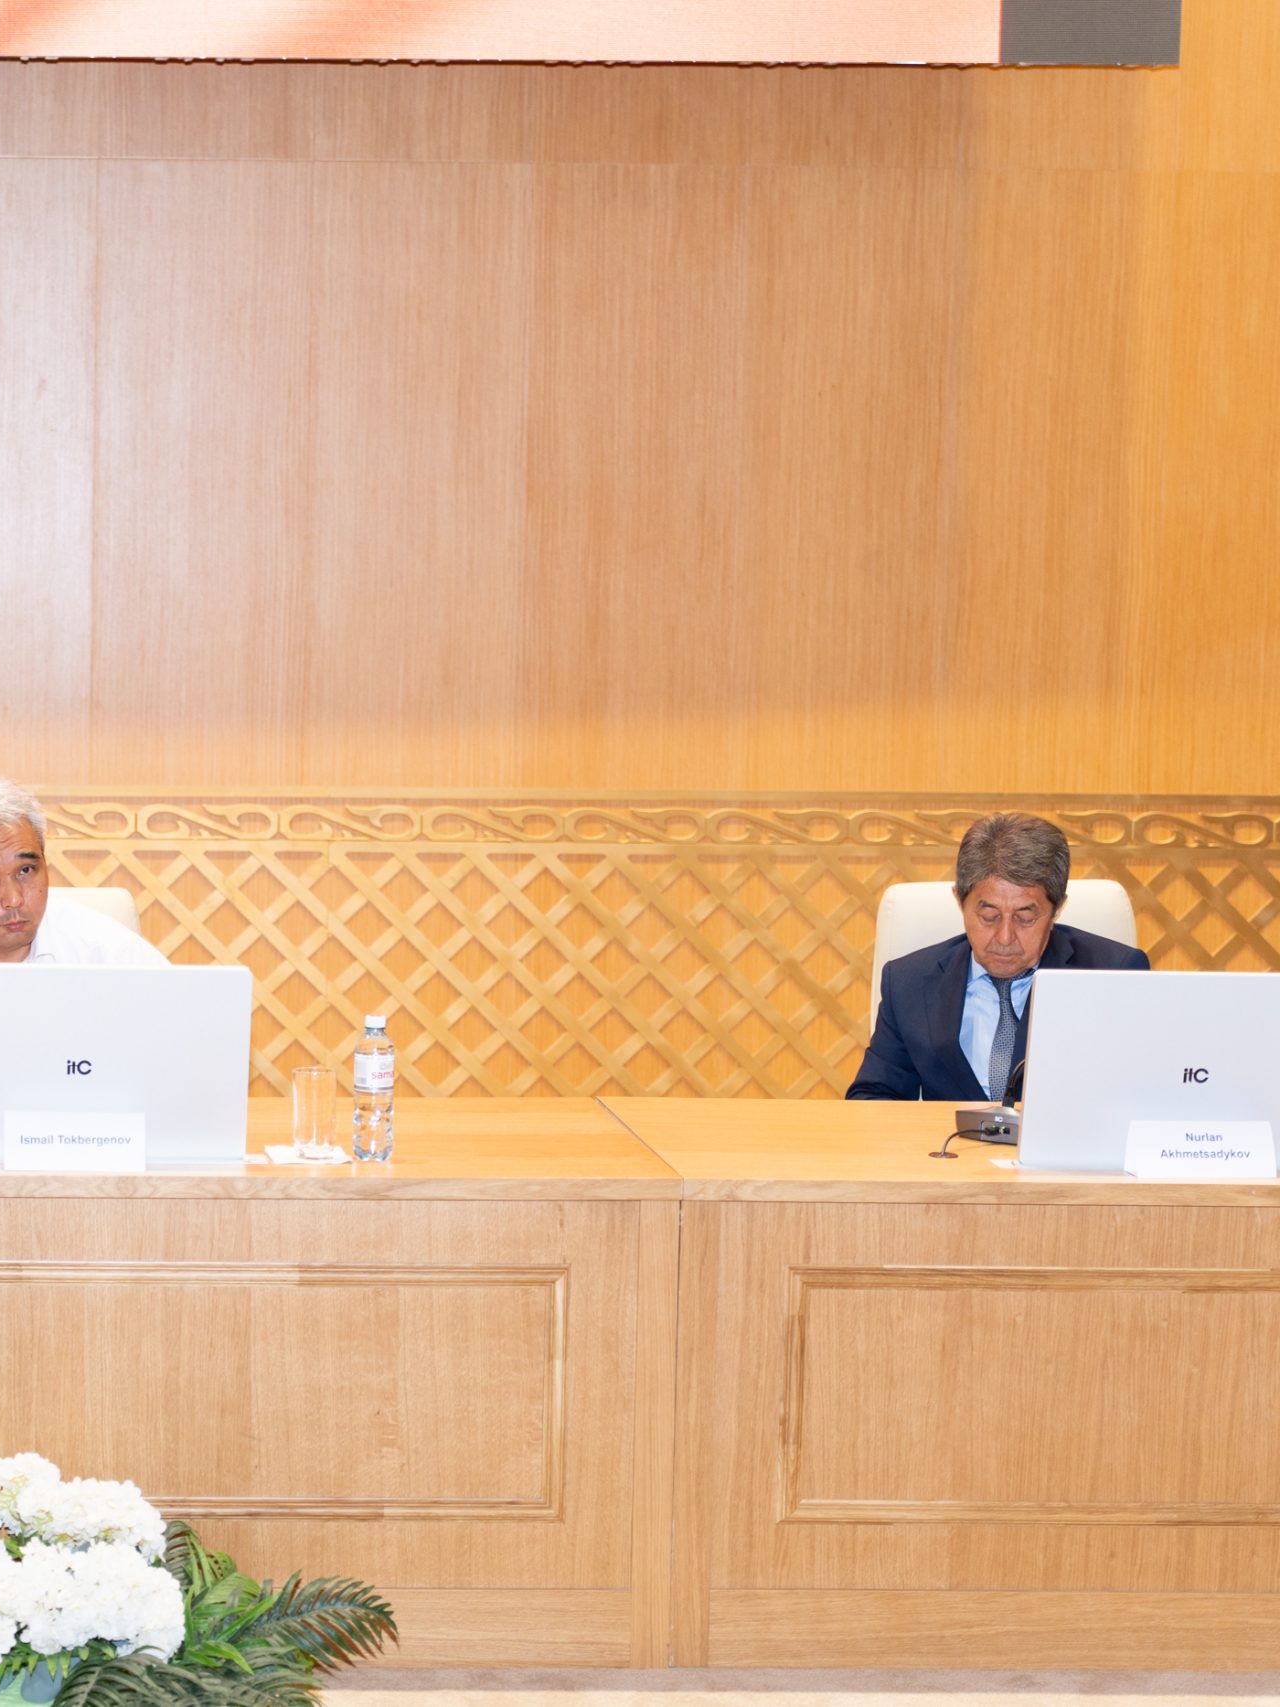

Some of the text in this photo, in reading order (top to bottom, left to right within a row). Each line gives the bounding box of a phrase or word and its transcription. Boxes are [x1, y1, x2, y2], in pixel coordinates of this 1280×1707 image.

[20, 1134, 131, 1147] Ismail Tokbergenov
[1185, 1132, 1223, 1142] Nurlan
[1160, 1148, 1251, 1160] Akhmetsadykov
